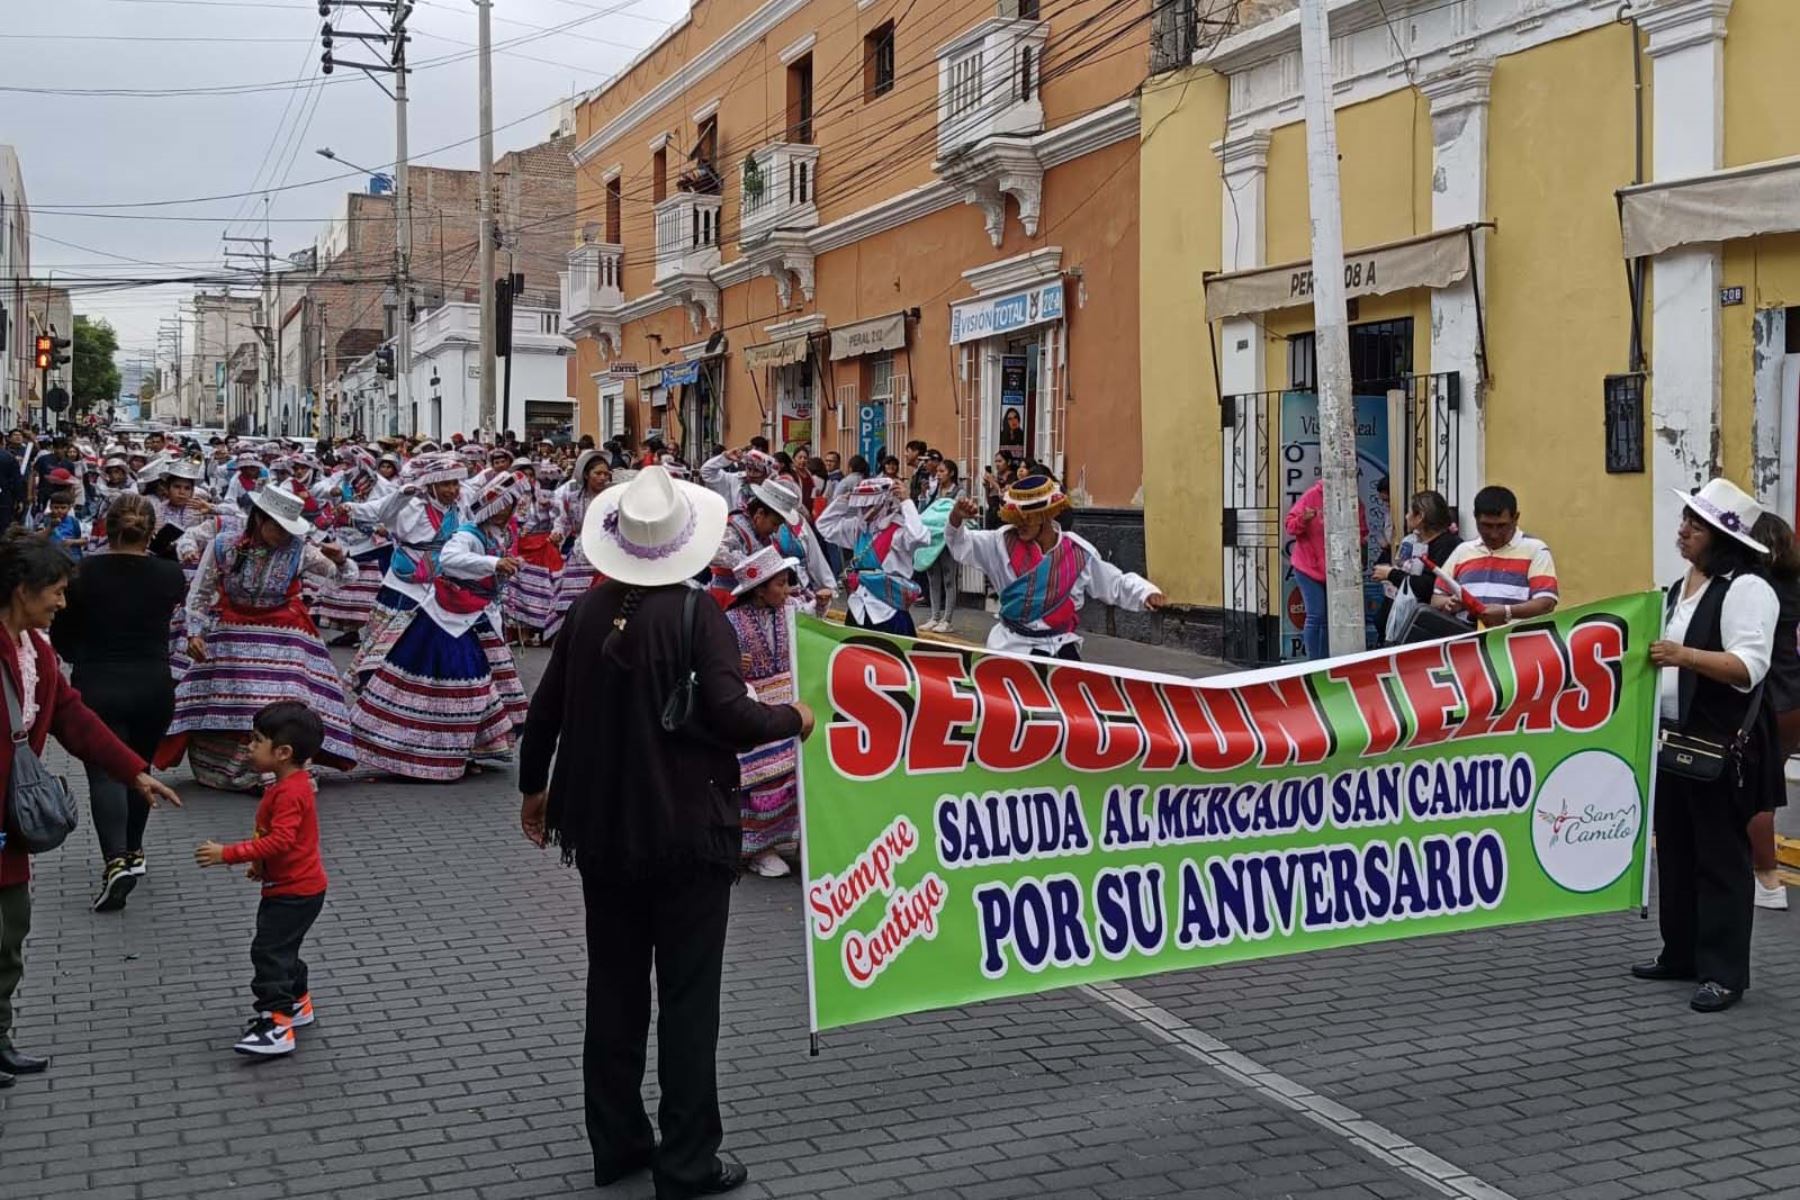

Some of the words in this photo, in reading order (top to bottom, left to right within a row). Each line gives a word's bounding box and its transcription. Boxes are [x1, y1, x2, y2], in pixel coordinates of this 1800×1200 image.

[1290, 270, 1315, 298] PER
[1343, 262, 1361, 290] 08
[1366, 260, 1377, 286] A
[961, 307, 992, 334] VISIÓN
[995, 300, 1026, 329] TOTAL
[849, 330, 870, 347] PERAL
[1356, 415, 1377, 436] eal
[1328, 620, 1624, 758] TELAS
[938, 790, 1088, 863] SALUDA
[1103, 788, 1150, 845] AL
[1157, 775, 1324, 840] MERCADO
[1332, 766, 1400, 824] SAN
[1408, 757, 1532, 816] CAMILO
[1580, 804, 1630, 824] San
[1565, 819, 1631, 845] Camilo
[808, 820, 914, 933] Siempre
[977, 878, 1091, 973] POR
[1096, 868, 1163, 954] SU
[1179, 833, 1504, 945] ANIVERSARIO
[845, 878, 943, 982] Contigo
